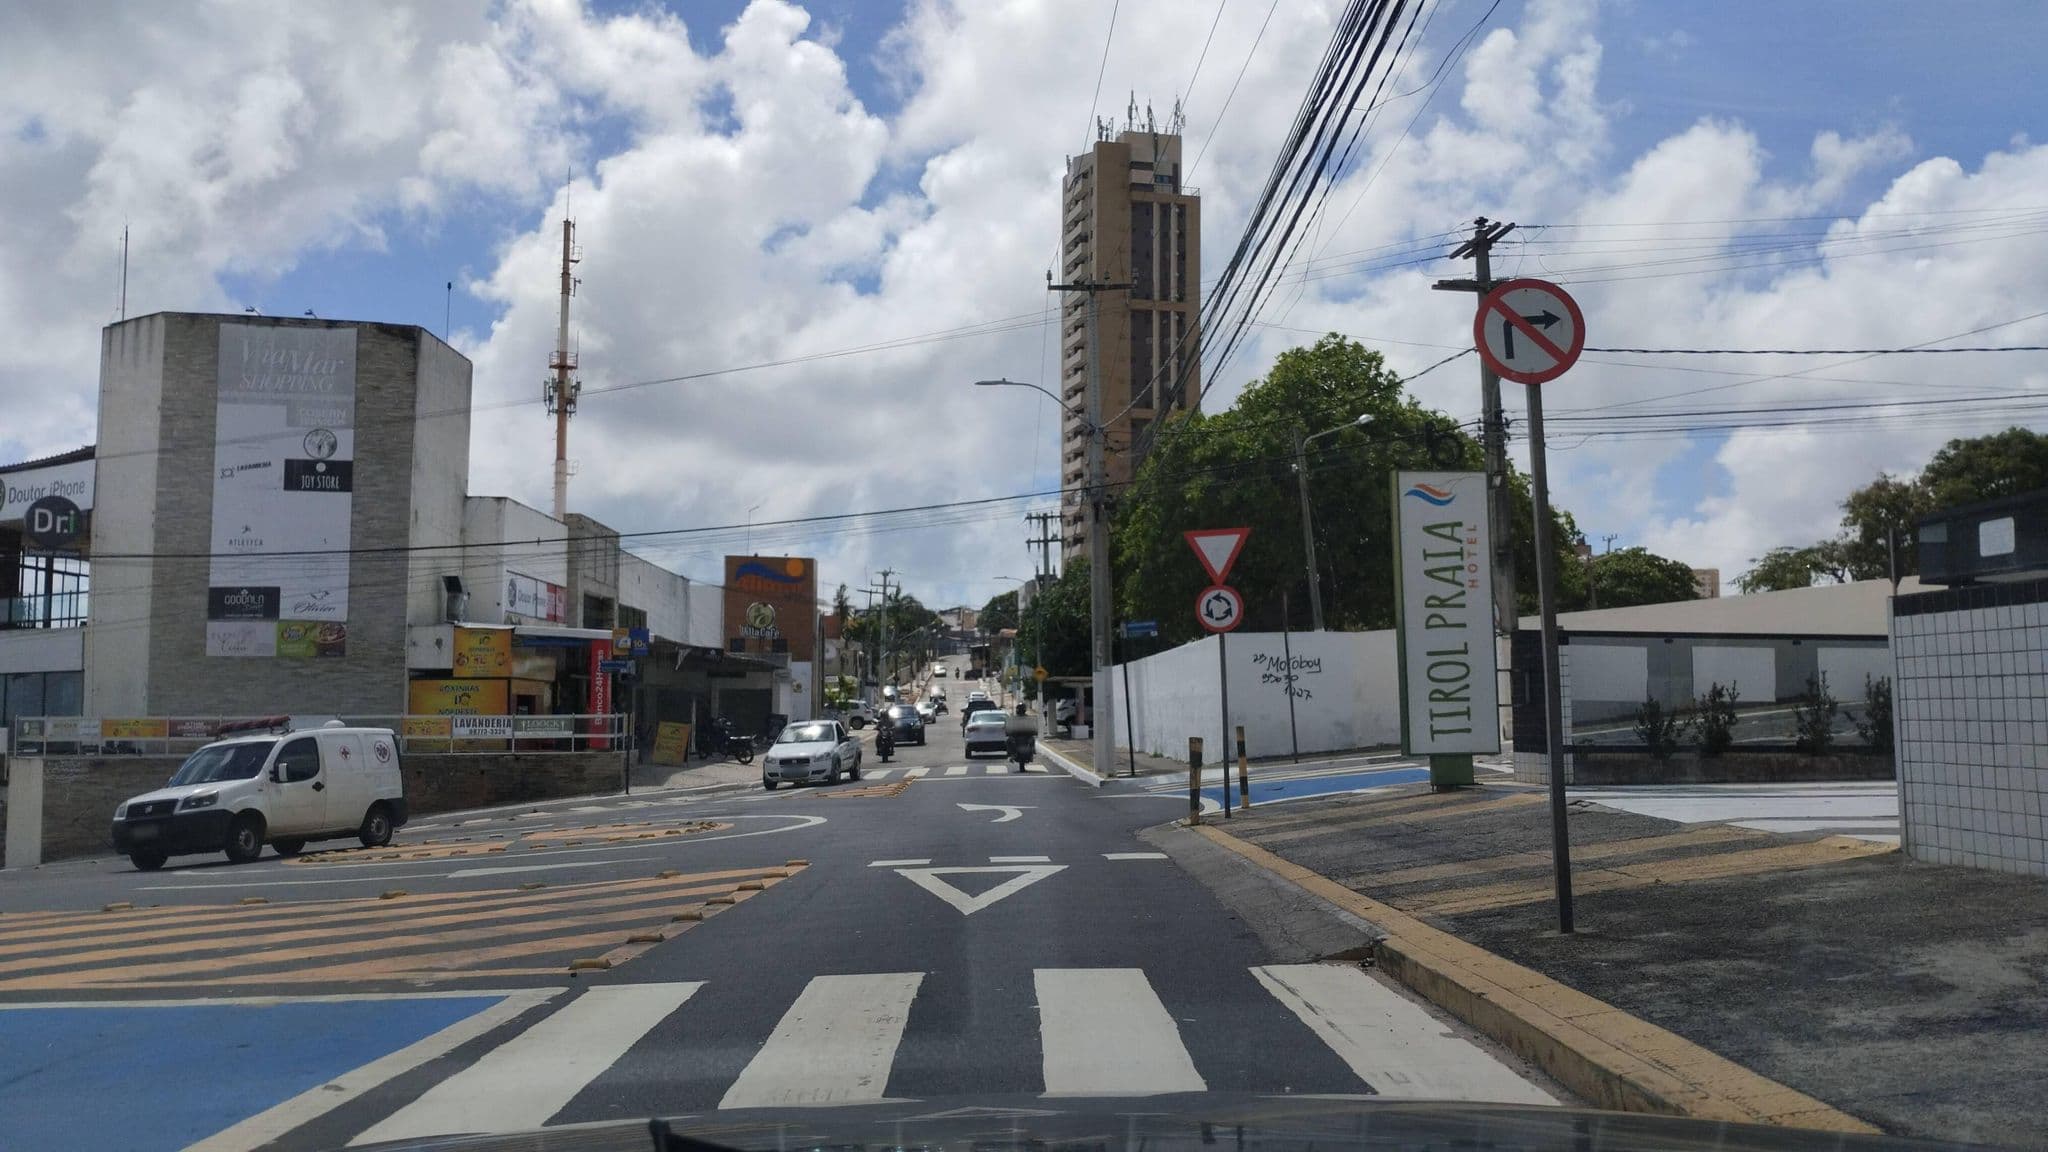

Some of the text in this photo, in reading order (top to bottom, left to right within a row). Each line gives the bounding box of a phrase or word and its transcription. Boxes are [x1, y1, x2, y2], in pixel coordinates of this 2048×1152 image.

[240, 373, 336, 392] SHOPPING
[301, 475, 340, 489] JOY STORE
[8, 480, 86, 504] Doutor iPhone
[1466, 524, 1478, 588] HOTEL
[1422, 521, 1472, 743] TIROL PRAIA
[1267, 655, 1321, 673] Mooboy
[454, 718, 512, 728] LAVANDERIA
